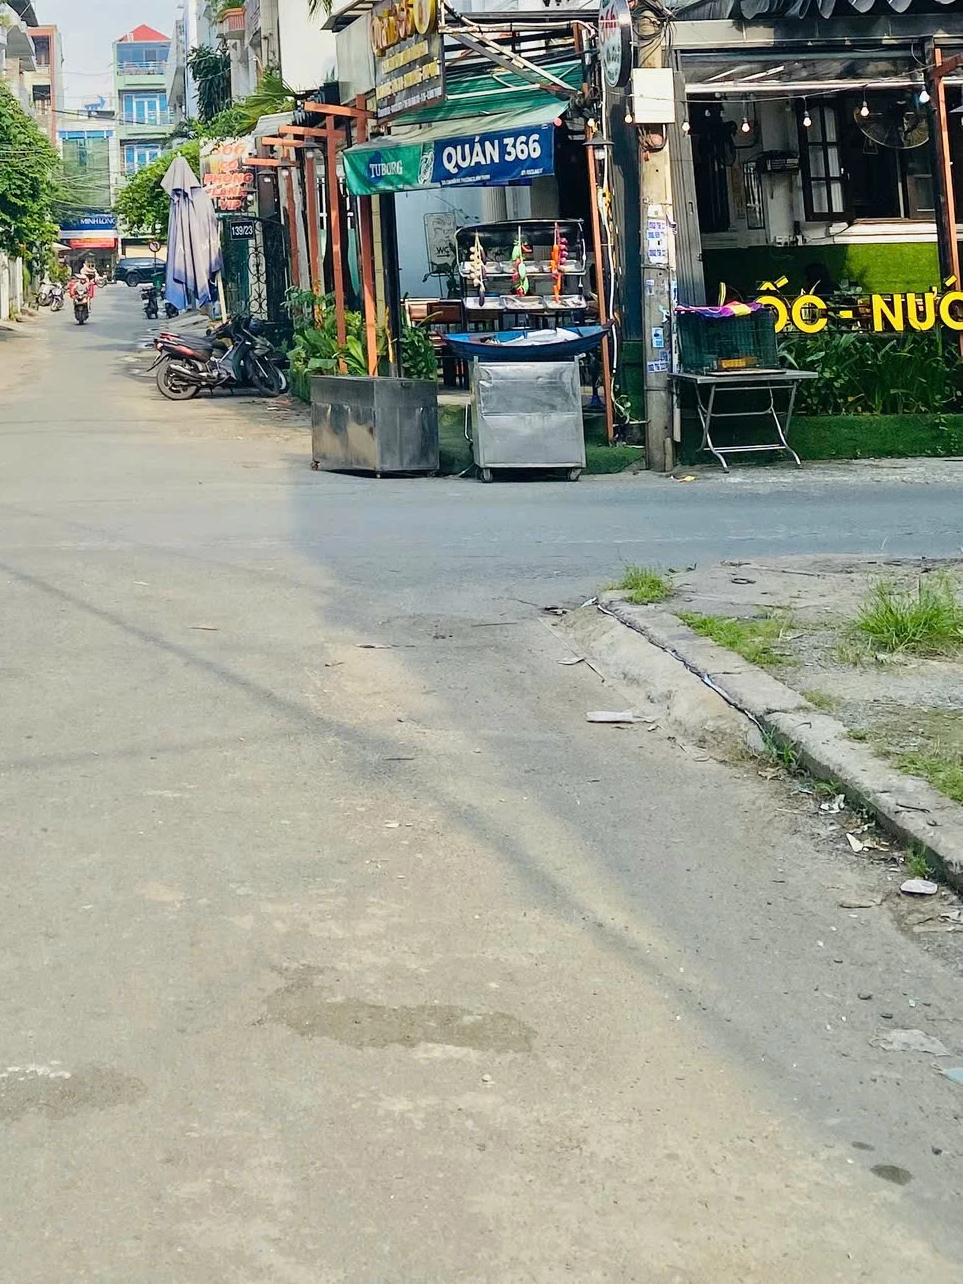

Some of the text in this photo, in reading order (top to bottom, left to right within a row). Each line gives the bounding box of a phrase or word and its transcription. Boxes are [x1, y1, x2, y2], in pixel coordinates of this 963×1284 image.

[442, 133, 542, 174] QUÁN 366
[369, 161, 403, 178] TUBORG
[231, 225, 254, 237] 139/23
